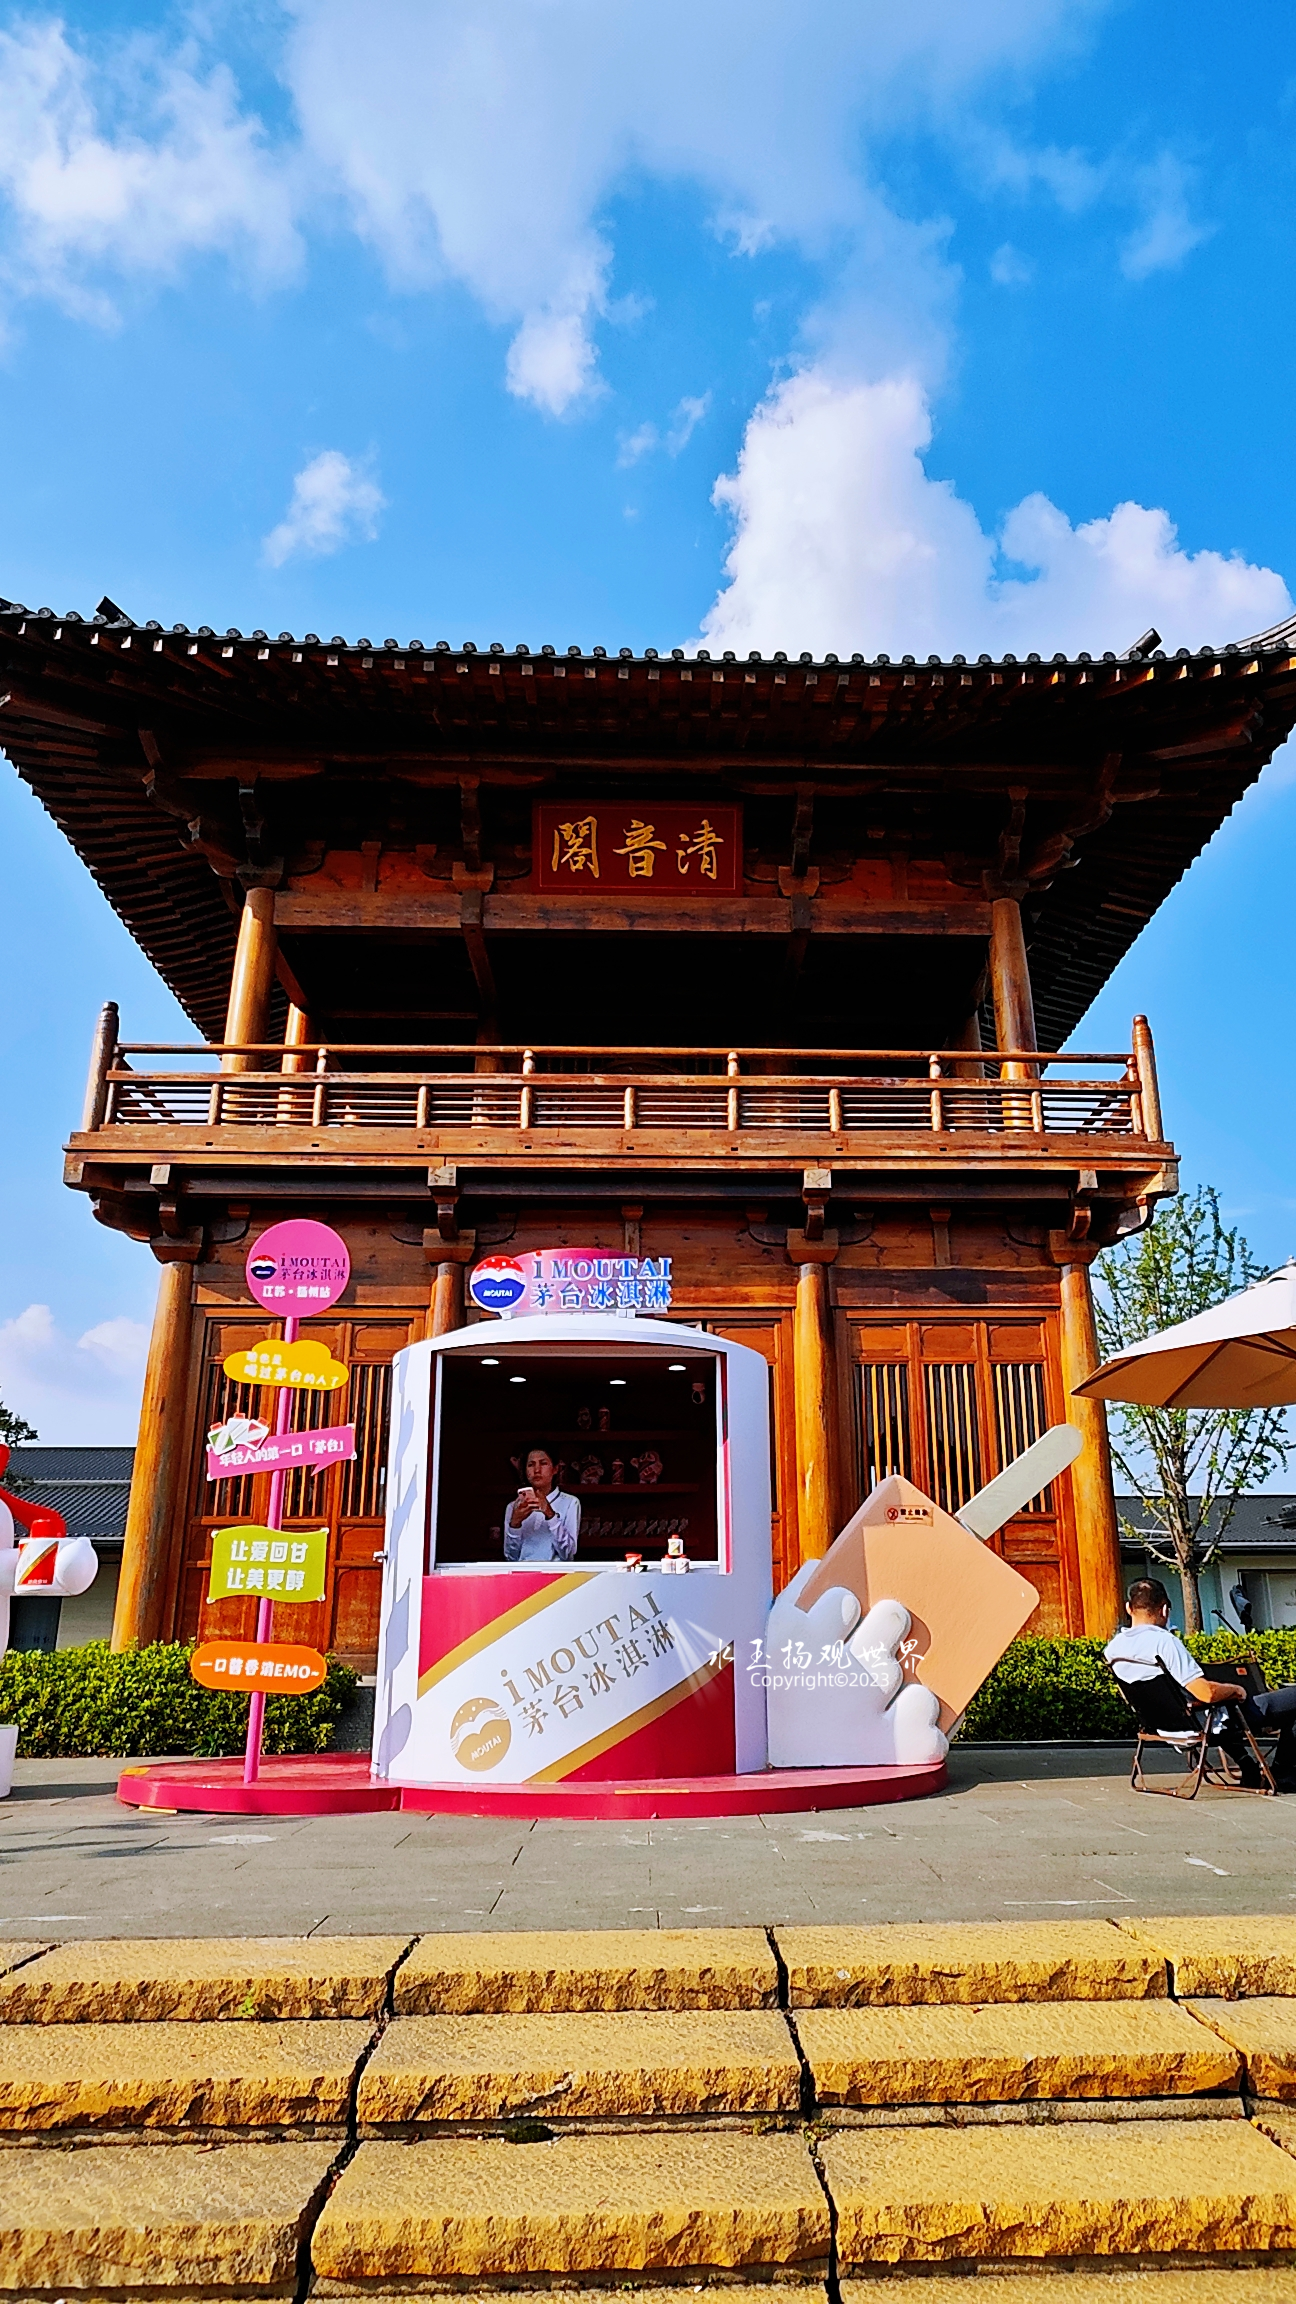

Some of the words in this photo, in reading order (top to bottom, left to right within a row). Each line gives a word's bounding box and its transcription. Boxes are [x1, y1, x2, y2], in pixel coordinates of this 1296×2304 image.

[279, 1268, 346, 1281] 茅台冰淇淋
[482, 1289, 513, 1298] MOUTAI
[530, 1281, 672, 1309] 茅台冰淇淋
[230, 1540, 308, 1563] 让爱回甘
[226, 1568, 305, 1591] 让美更醇
[516, 1619, 676, 1738] 茅台冰淇淋
[470, 1735, 502, 1761] MOUTAI
